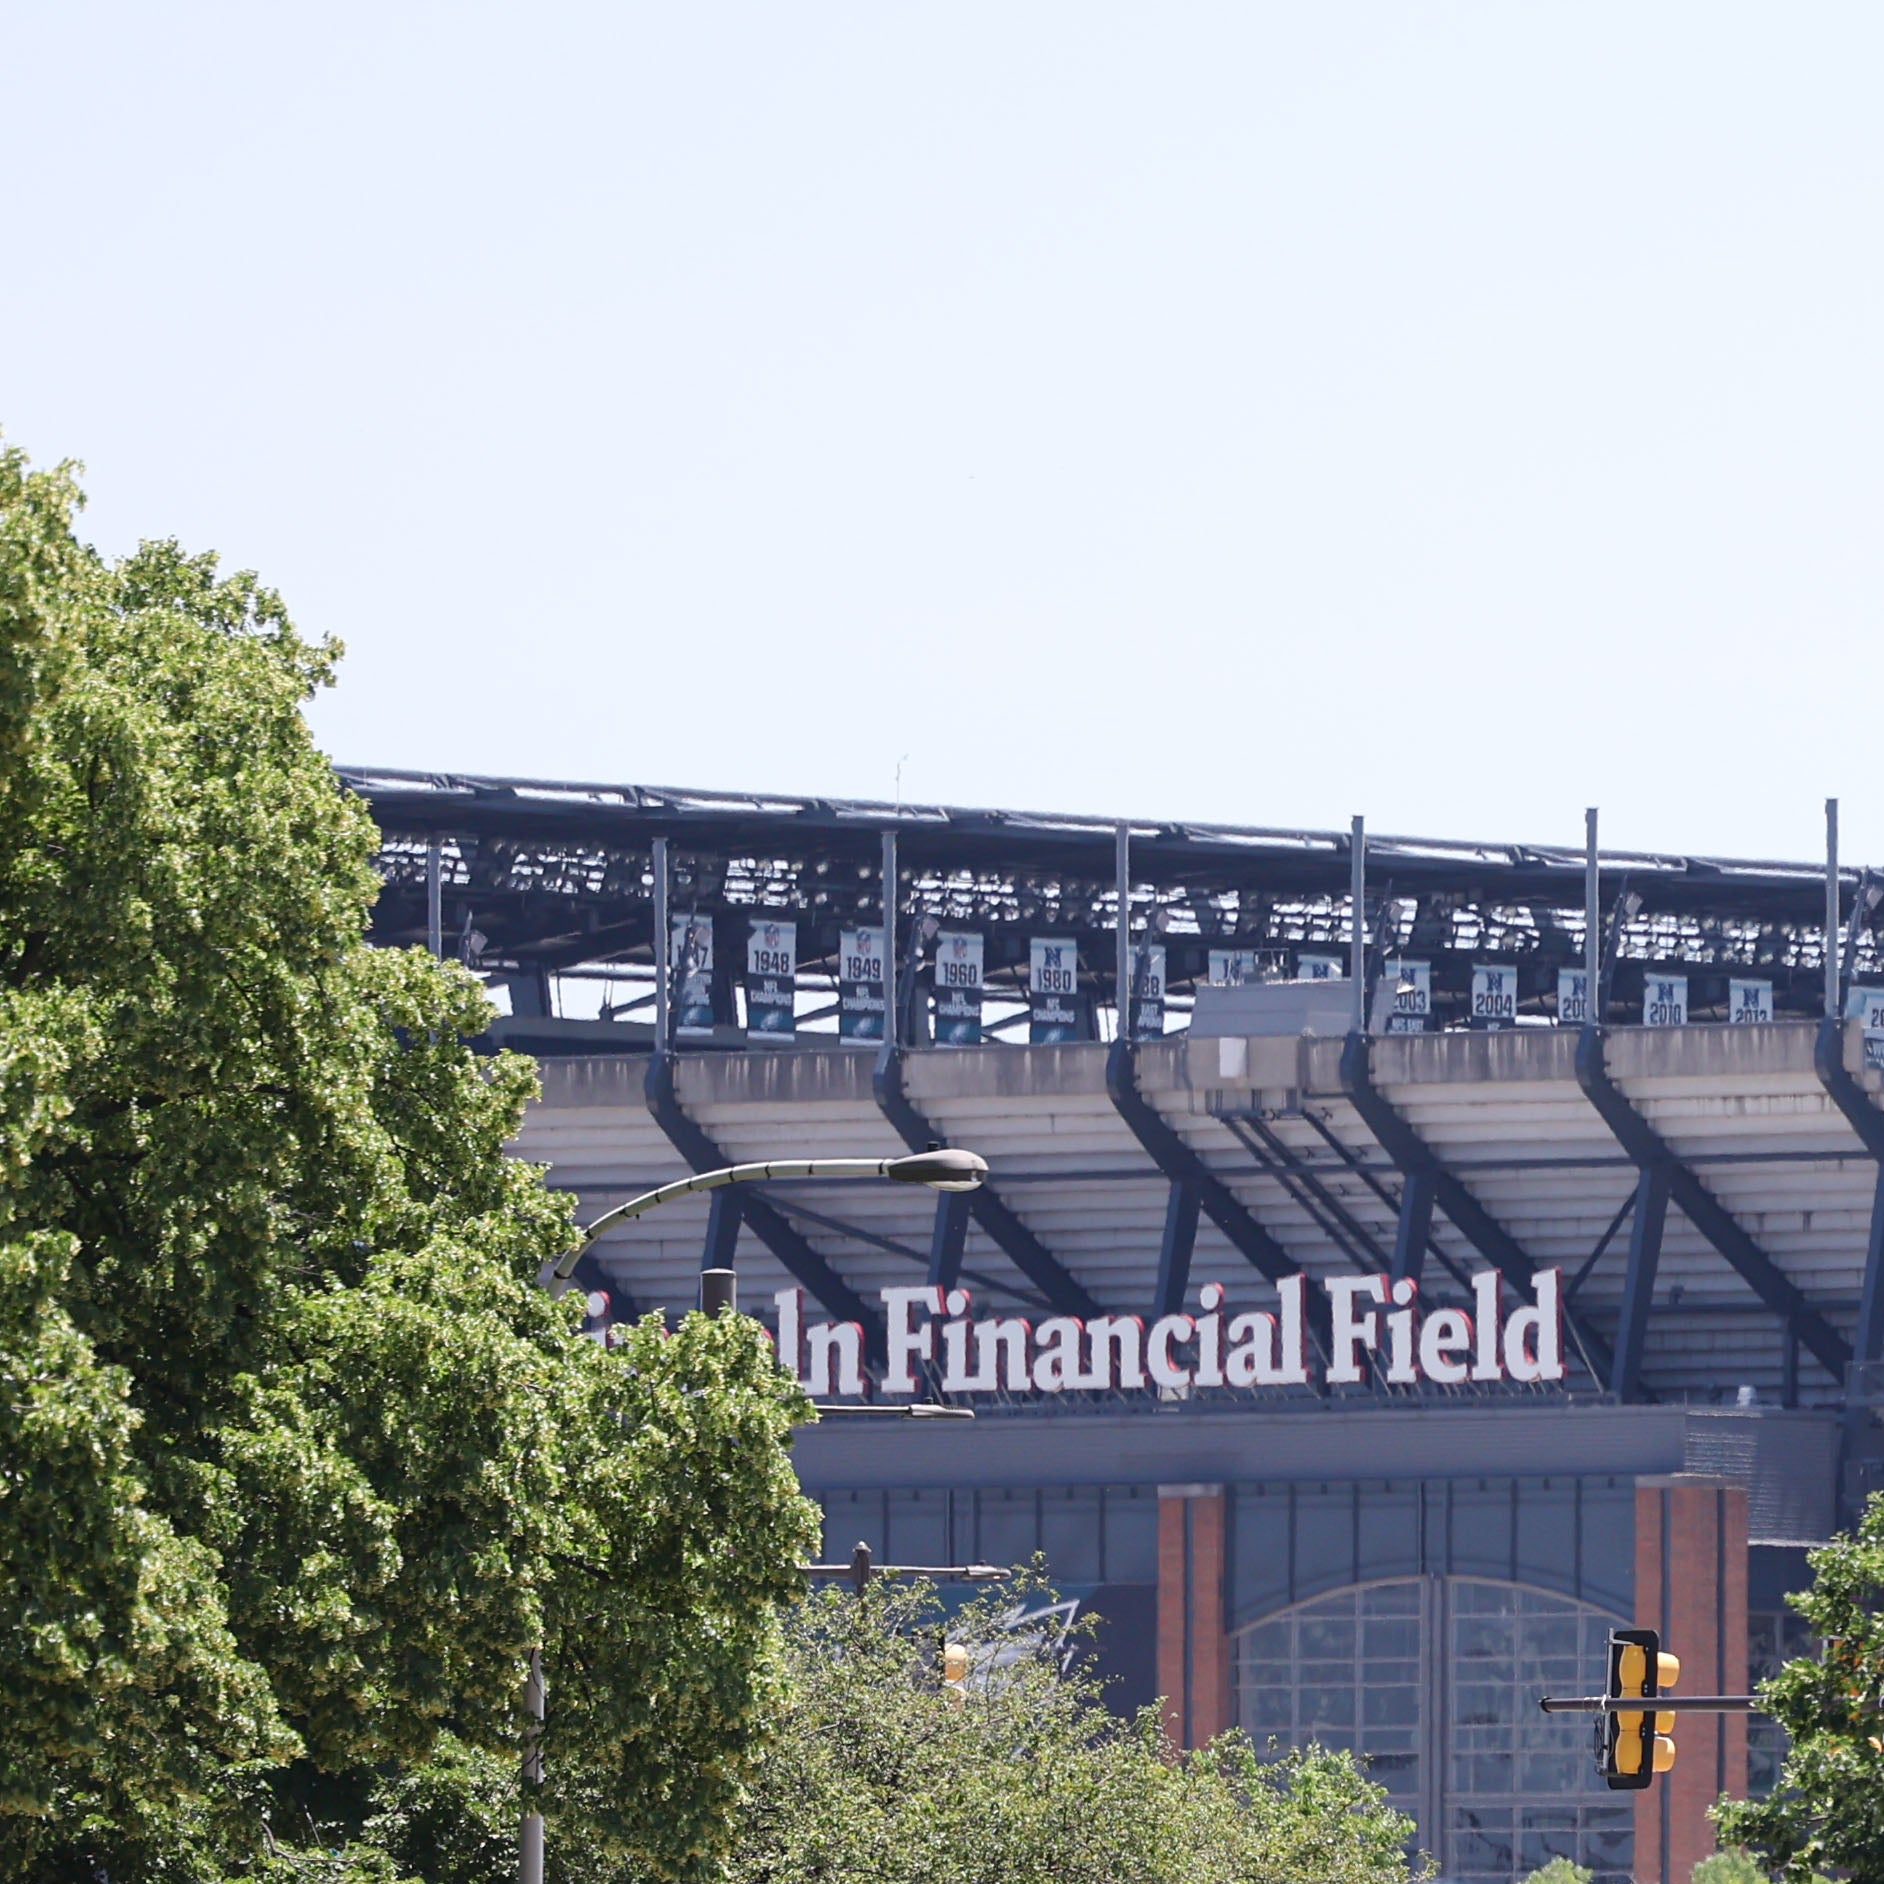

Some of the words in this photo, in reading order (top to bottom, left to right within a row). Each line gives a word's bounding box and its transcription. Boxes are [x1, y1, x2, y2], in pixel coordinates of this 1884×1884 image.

[754, 950, 790, 973] 1948
[943, 963, 977, 985] 1960
[1037, 968, 1071, 992] 1980
[1476, 993, 1513, 1015] 2004
[881, 1270, 1312, 1392] Financial
[1324, 1265, 1568, 1385] Field
